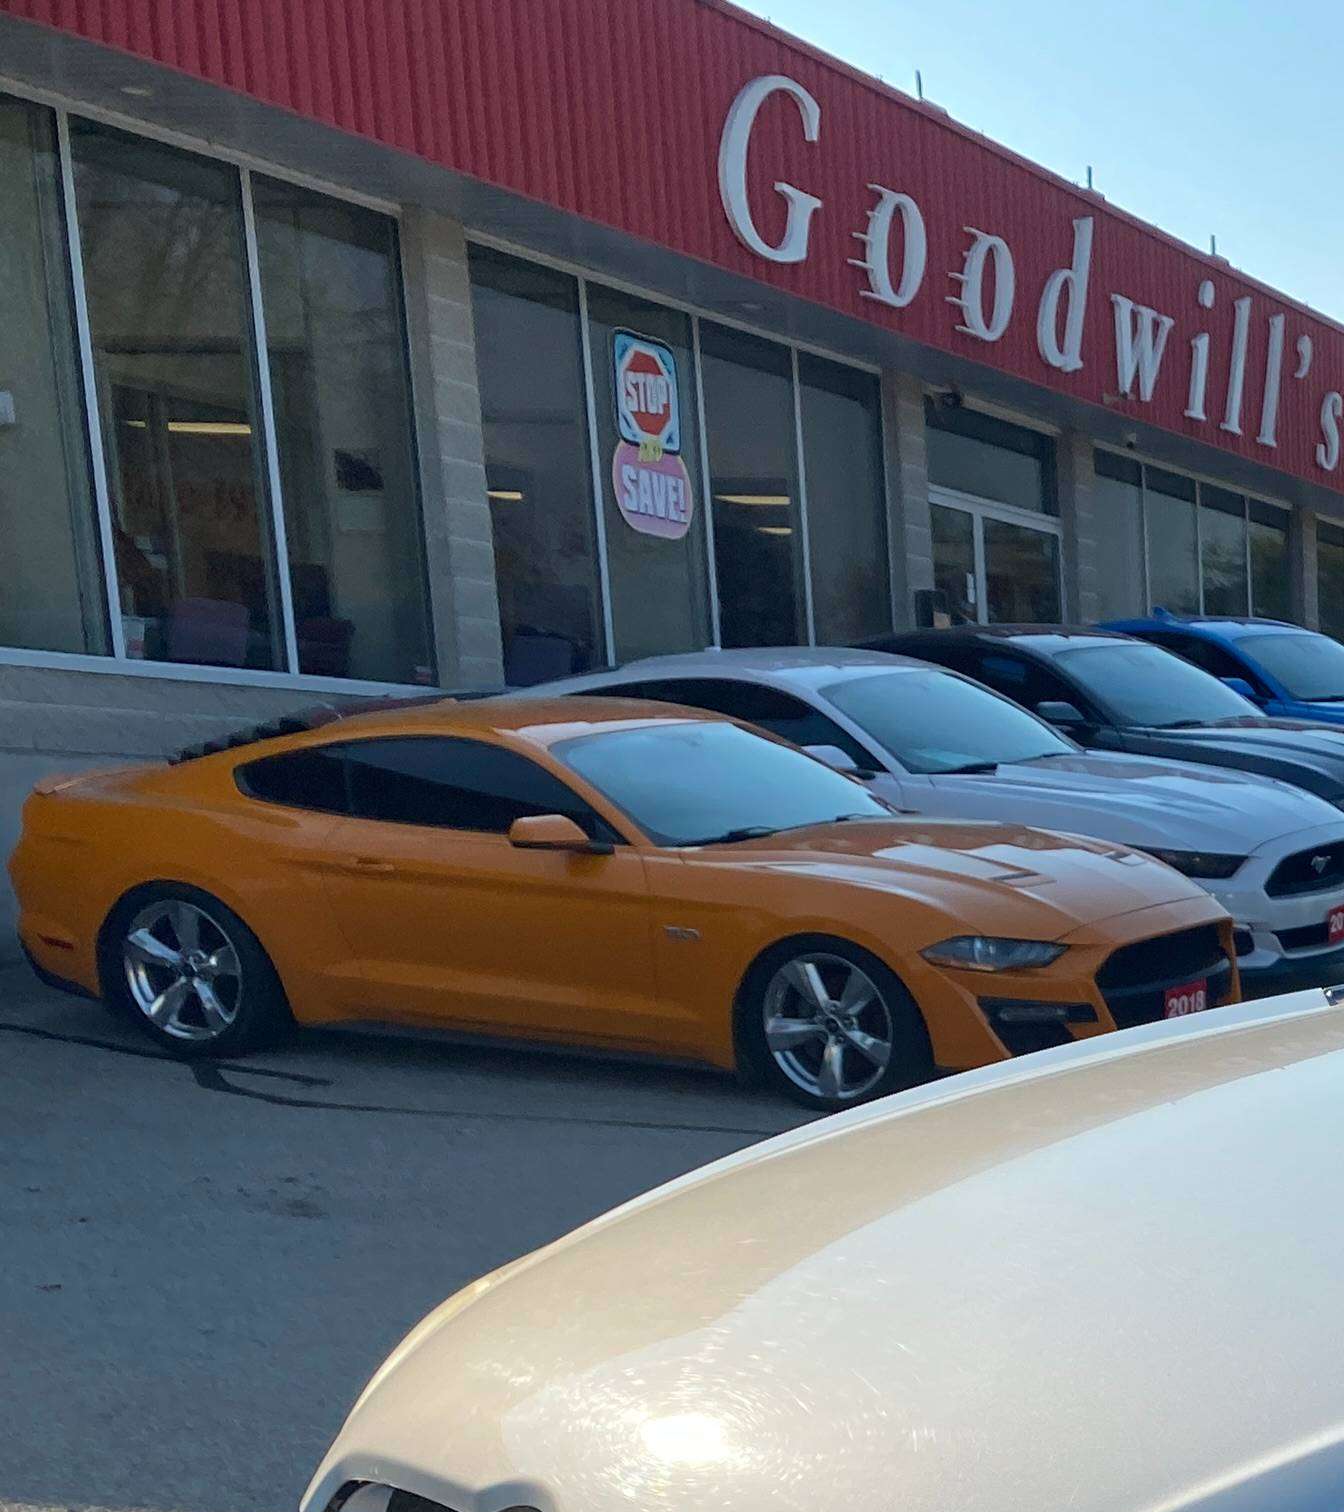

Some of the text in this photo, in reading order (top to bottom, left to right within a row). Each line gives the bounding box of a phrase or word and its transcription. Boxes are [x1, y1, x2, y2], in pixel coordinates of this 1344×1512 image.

[718, 75, 1343, 471] Goodwill's
[621, 464, 688, 524] SAVE!
[1168, 990, 1206, 1018] 2018
